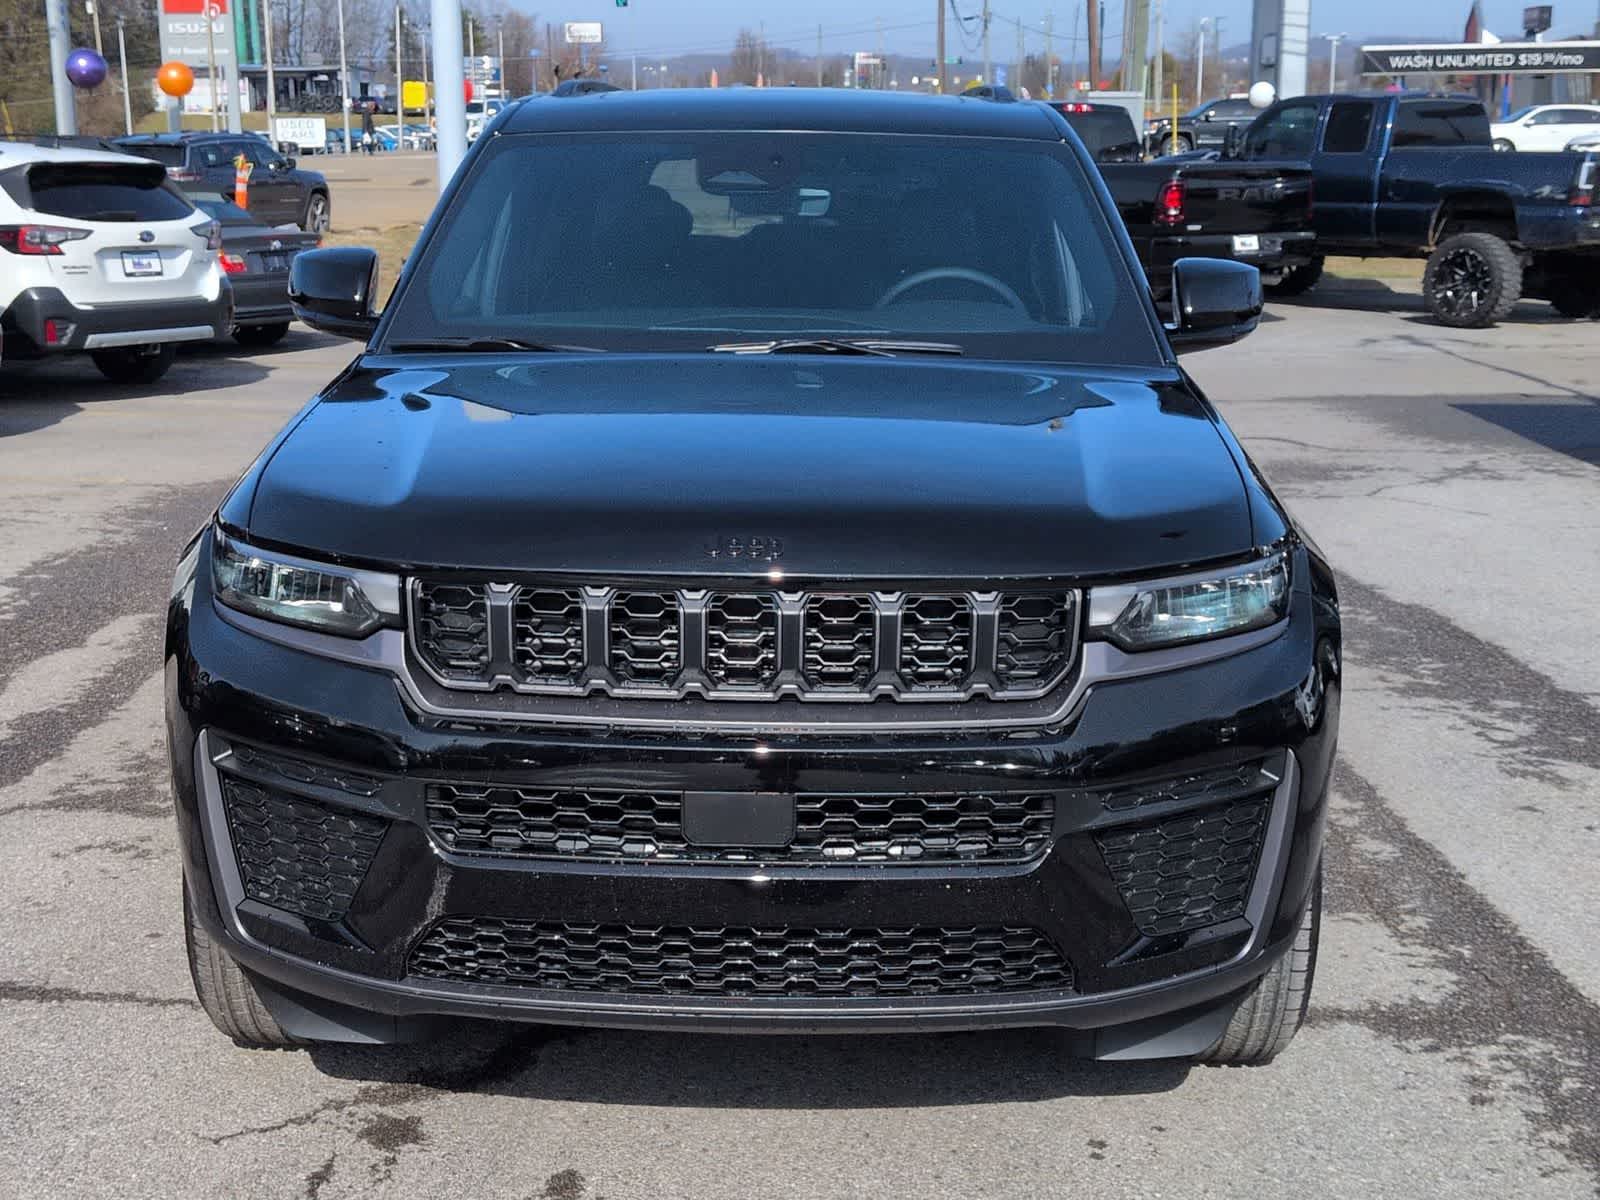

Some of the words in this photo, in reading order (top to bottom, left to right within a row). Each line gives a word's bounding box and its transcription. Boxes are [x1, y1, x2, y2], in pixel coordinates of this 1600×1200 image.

[168, 23, 225, 34] ISUZU
[1389, 54, 1433, 69] WASH
[1435, 53, 1516, 68] UNLIMITED
[280, 119, 314, 129] USED
[1217, 187, 1284, 201] RAM
